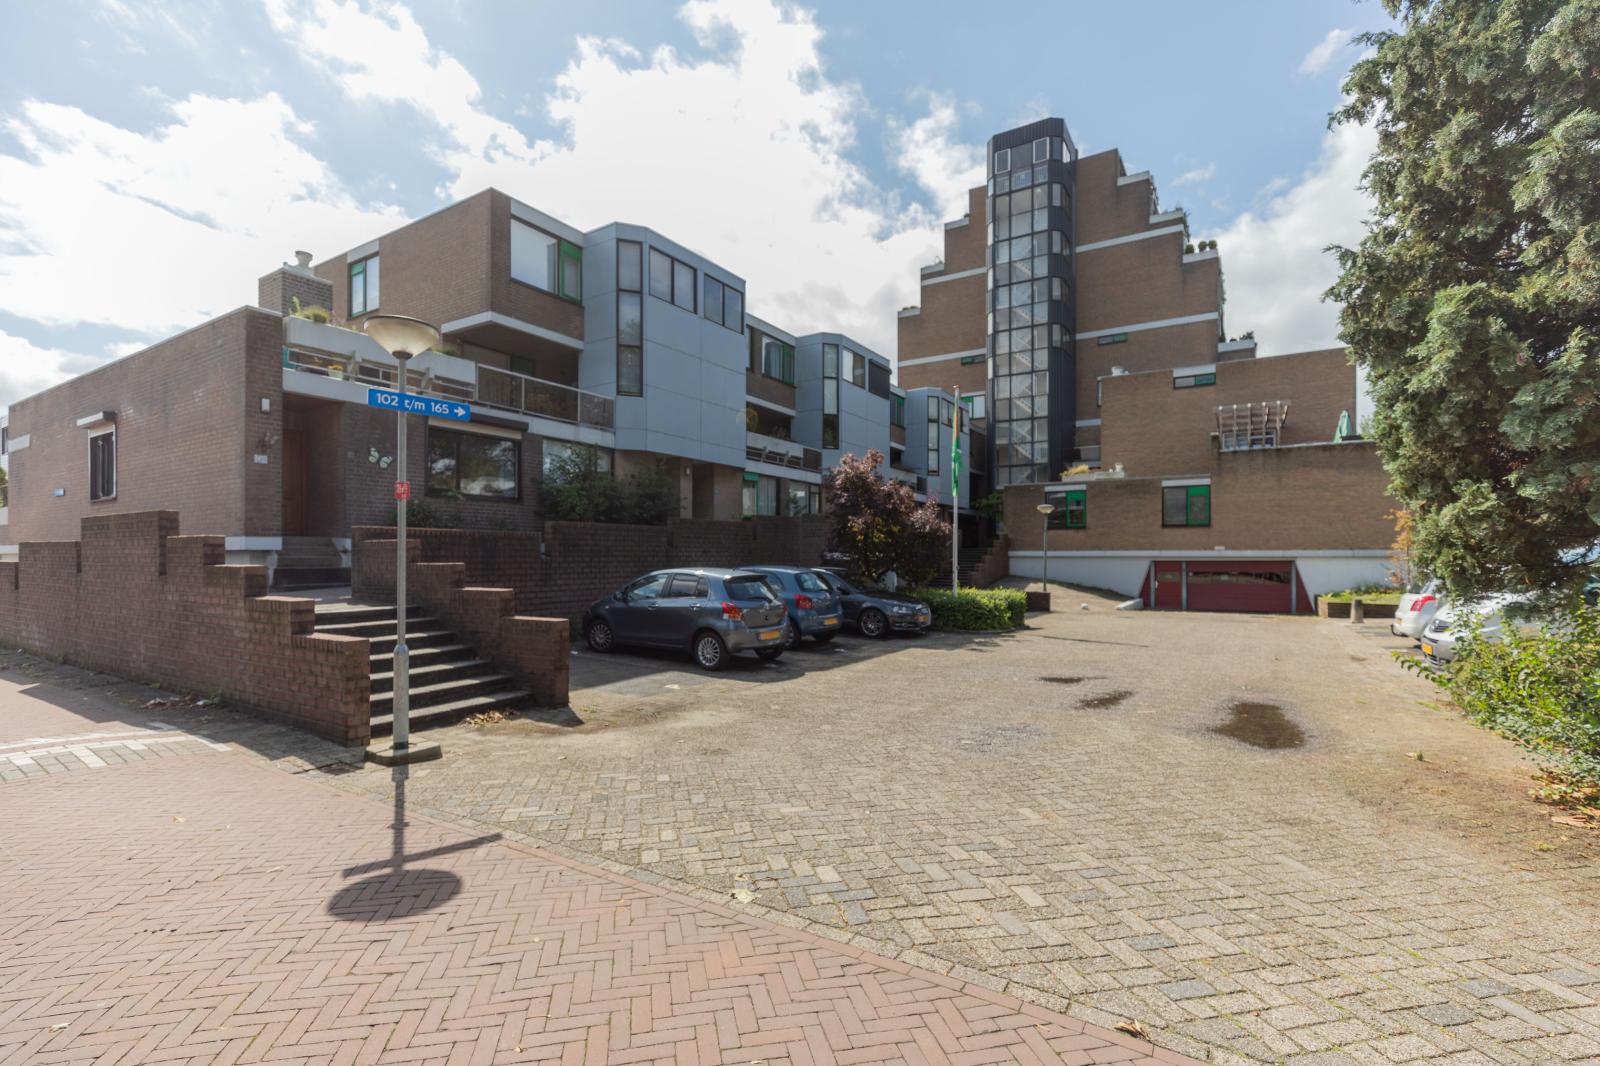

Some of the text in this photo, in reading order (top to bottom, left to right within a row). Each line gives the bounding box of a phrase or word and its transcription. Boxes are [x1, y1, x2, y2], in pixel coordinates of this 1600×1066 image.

[376, 393, 449, 414] 102 t/m 165
